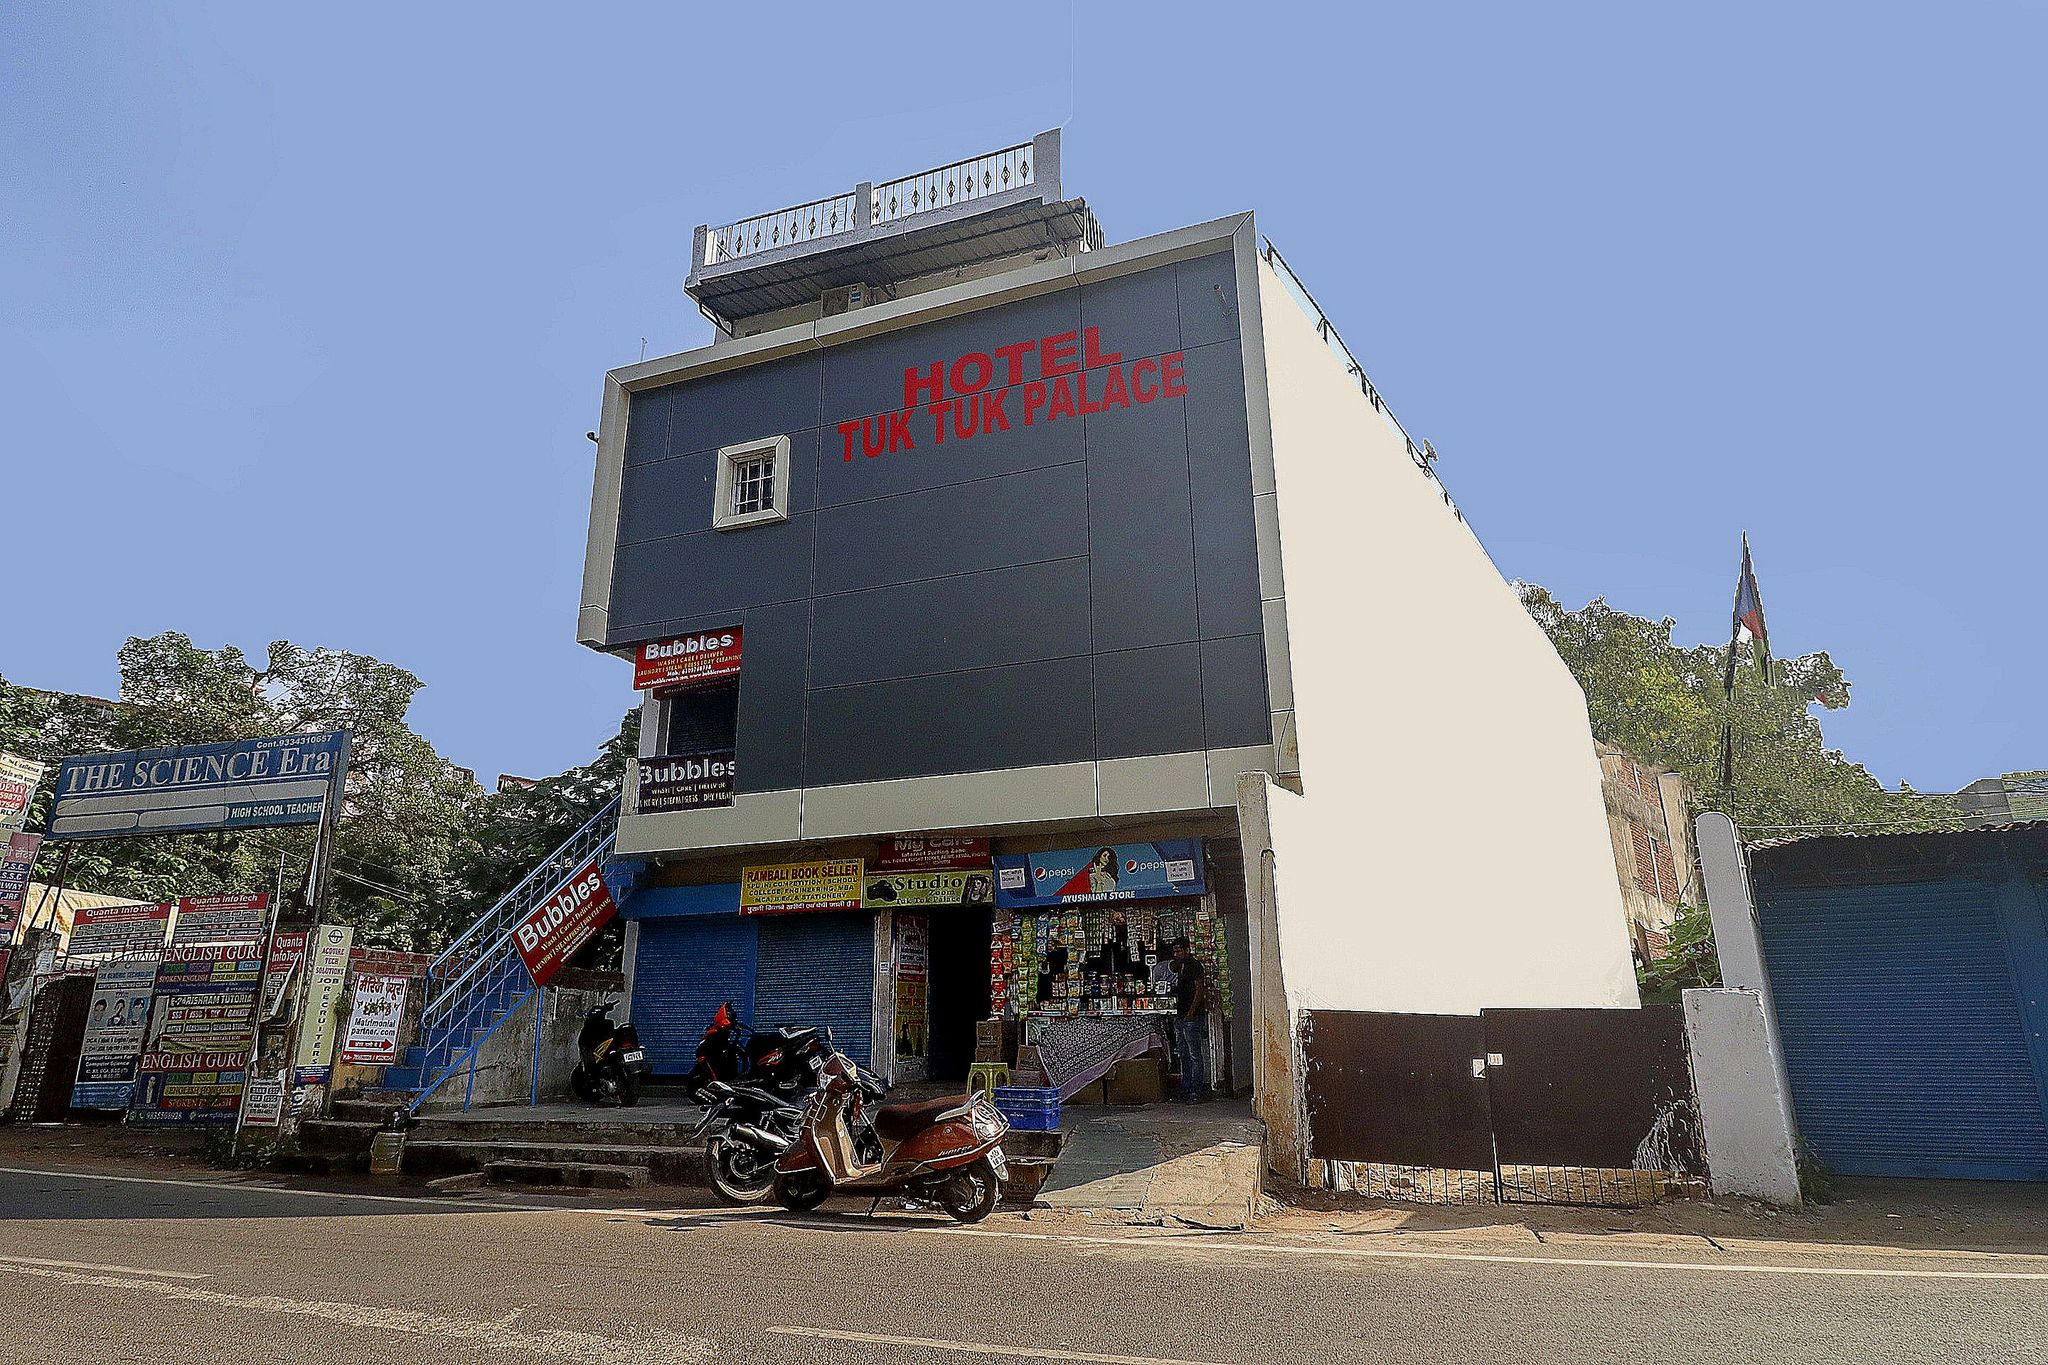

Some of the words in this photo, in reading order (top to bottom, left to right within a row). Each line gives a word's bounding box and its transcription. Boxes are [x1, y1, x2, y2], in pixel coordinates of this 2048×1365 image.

[903, 326, 1122, 408] HOTEL
[837, 409, 915, 462] TUK
[928, 388, 1011, 444] TUK
[1023, 352, 1188, 427] PALACE
[645, 634, 734, 660] Bubbles
[657, 658, 676, 667] WASH
[680, 655, 695, 664] CARE
[699, 651, 724, 660] DELIVER
[66, 763, 125, 793] THE
[131, 750, 271, 787] SCIENCE
[277, 747, 331, 778] Era
[640, 759, 735, 784] Bubbles
[231, 805, 251, 819] HIGH
[252, 803, 285, 818] SCHOOL
[286, 801, 323, 815] TEACHER
[747, 868, 789, 882] RAMBALI
[792, 866, 820, 879] BOOK
[821, 864, 859, 878] SELLER
[1048, 867, 1076, 879] pepsi
[828, 877, 857, 885] SCHOOL
[894, 875, 963, 891] Studio
[190, 897, 220, 906] Quanta
[222, 894, 258, 903] InfoTech
[802, 892, 847, 901] STATIONERY
[928, 889, 956, 897] Zoom
[931, 895, 961, 905] Palace
[1061, 891, 1108, 904] AYUSHMAN
[1109, 889, 1136, 901] STORE
[86, 908, 118, 917] Quanta
[121, 904, 159, 914] InfoTech
[518, 873, 600, 952] Bubbles
[541, 934, 557, 951] Wash
[560, 920, 573, 934] Care
[574, 901, 593, 920] Deliver
[277, 937, 303, 948] Quanta
[163, 947, 223, 962] ENGLISH
[272, 949, 302, 962] InfoTech
[315, 967, 344, 975] SOLUTIONS
[354, 1018, 396, 1028] Matrimonial
[141, 1053, 202, 1069] ENGLISH
[206, 1052, 246, 1068] GURU
